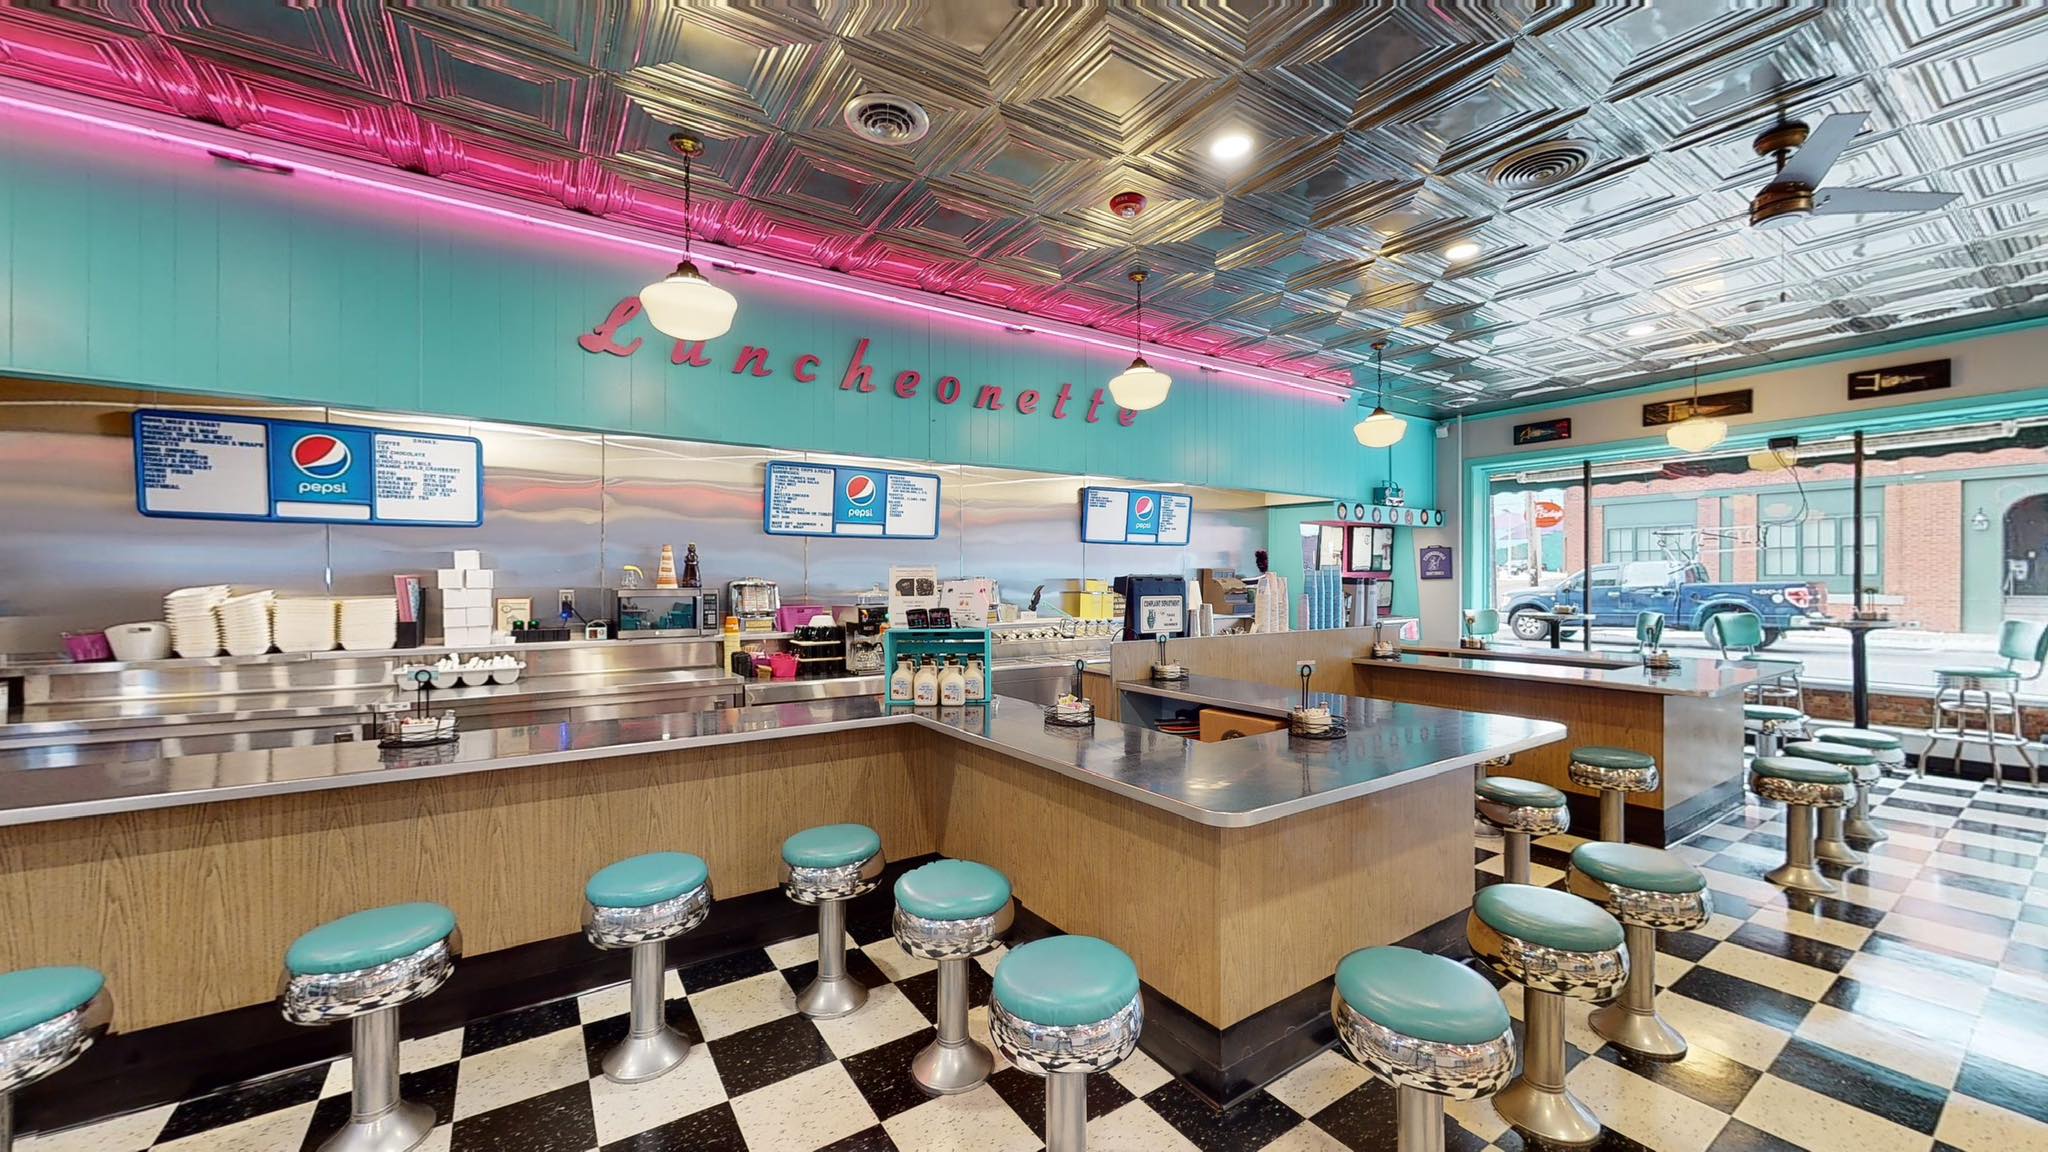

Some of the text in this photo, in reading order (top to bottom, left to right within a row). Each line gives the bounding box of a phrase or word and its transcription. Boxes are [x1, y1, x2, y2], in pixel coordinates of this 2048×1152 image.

[577, 296, 1139, 427] Luncheonette
[299, 482, 348, 495] pepsi
[848, 508, 873, 518] pepsi
